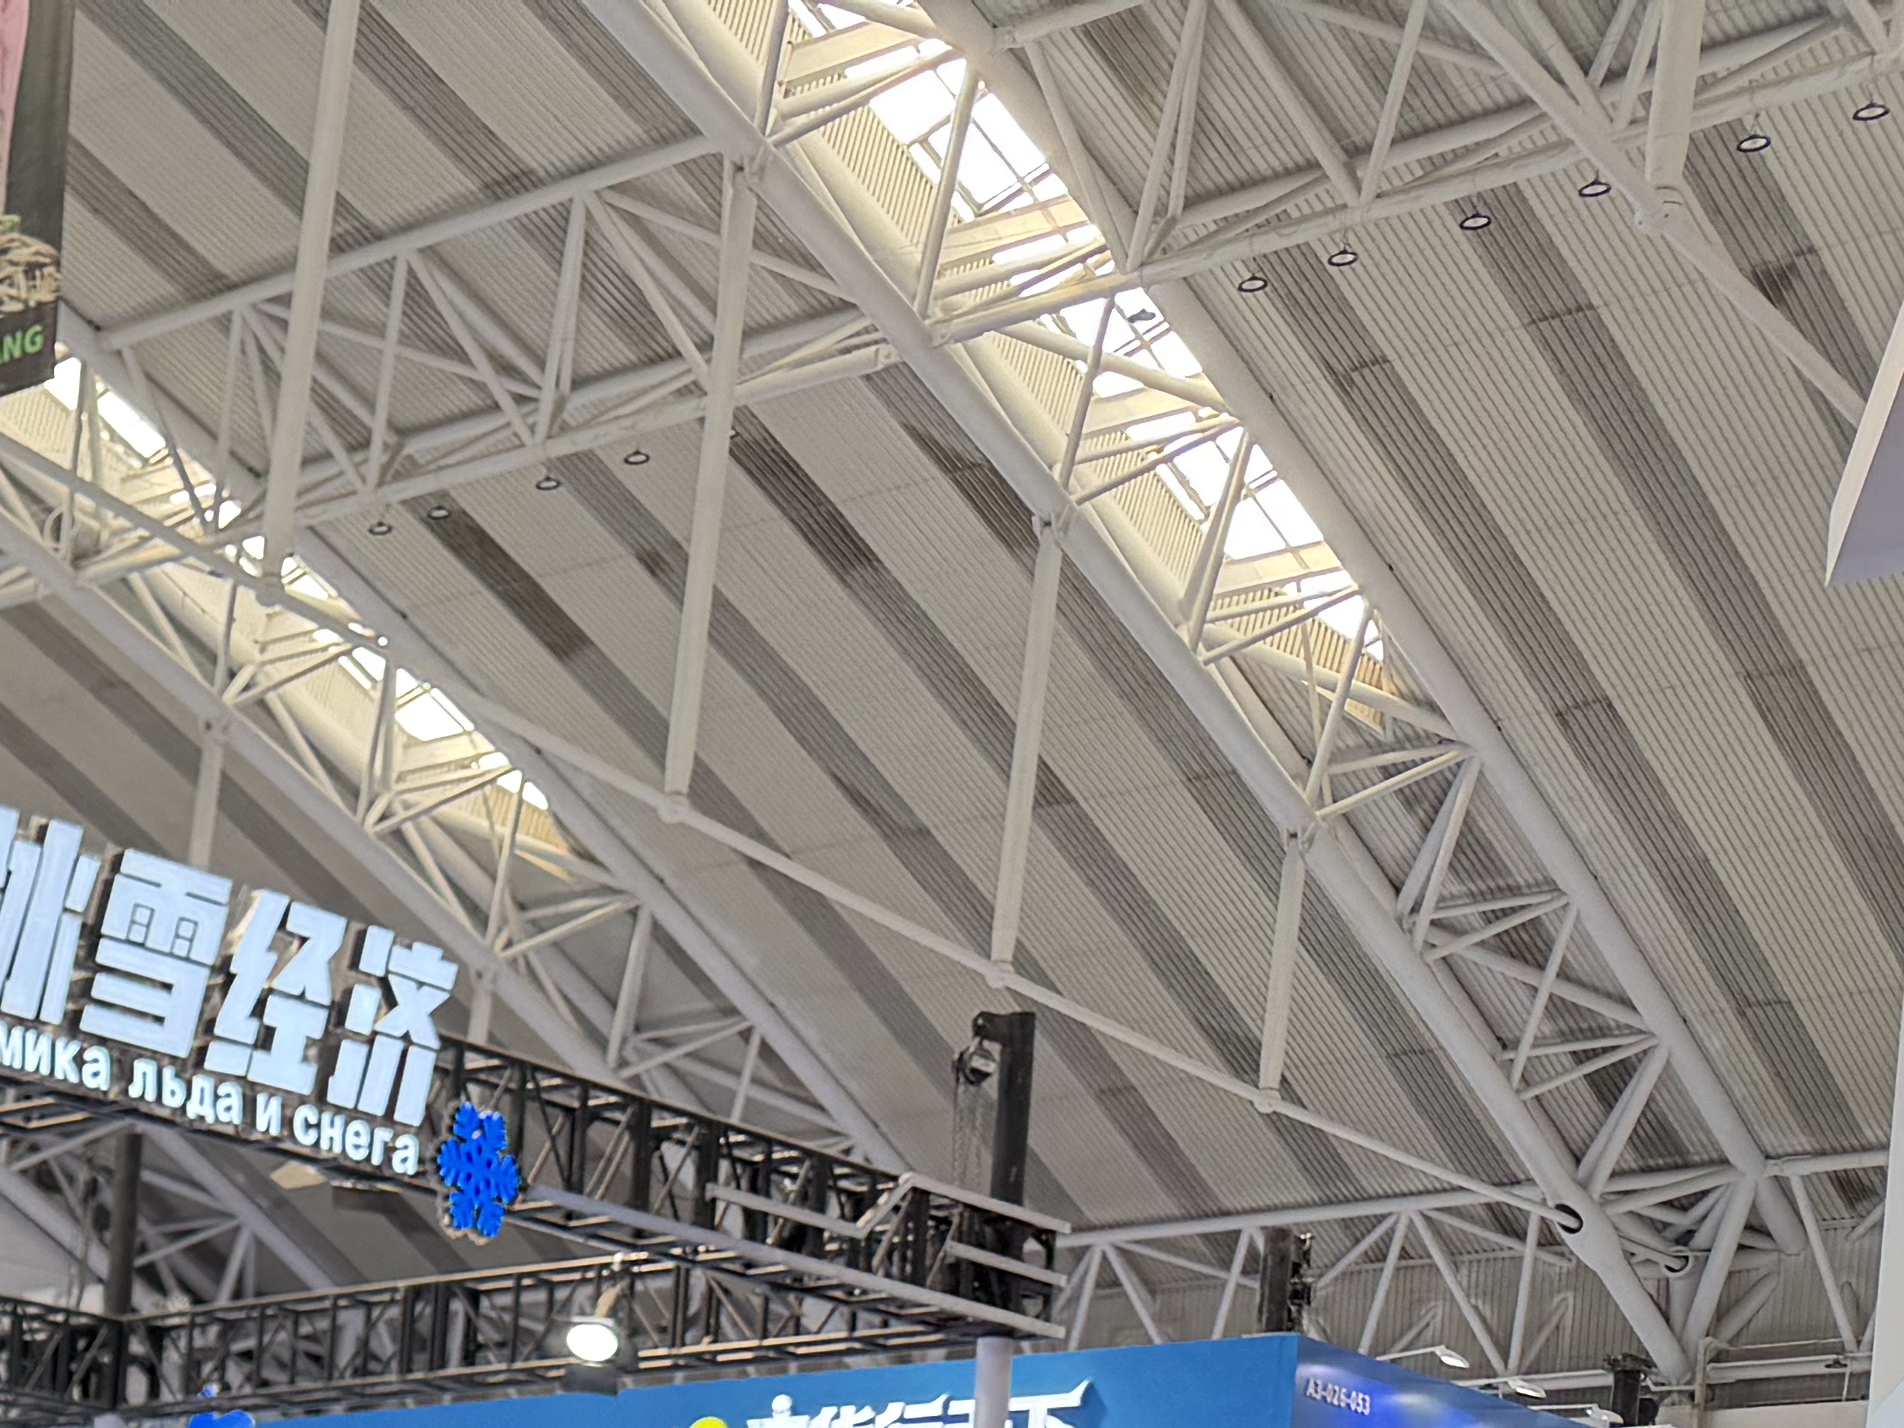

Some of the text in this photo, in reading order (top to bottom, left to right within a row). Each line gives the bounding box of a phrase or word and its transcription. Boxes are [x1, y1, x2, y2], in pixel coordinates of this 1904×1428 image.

[128, 1058, 244, 1126] льда
[255, 1091, 283, 1135] и
[292, 1104, 420, 1177] снега
